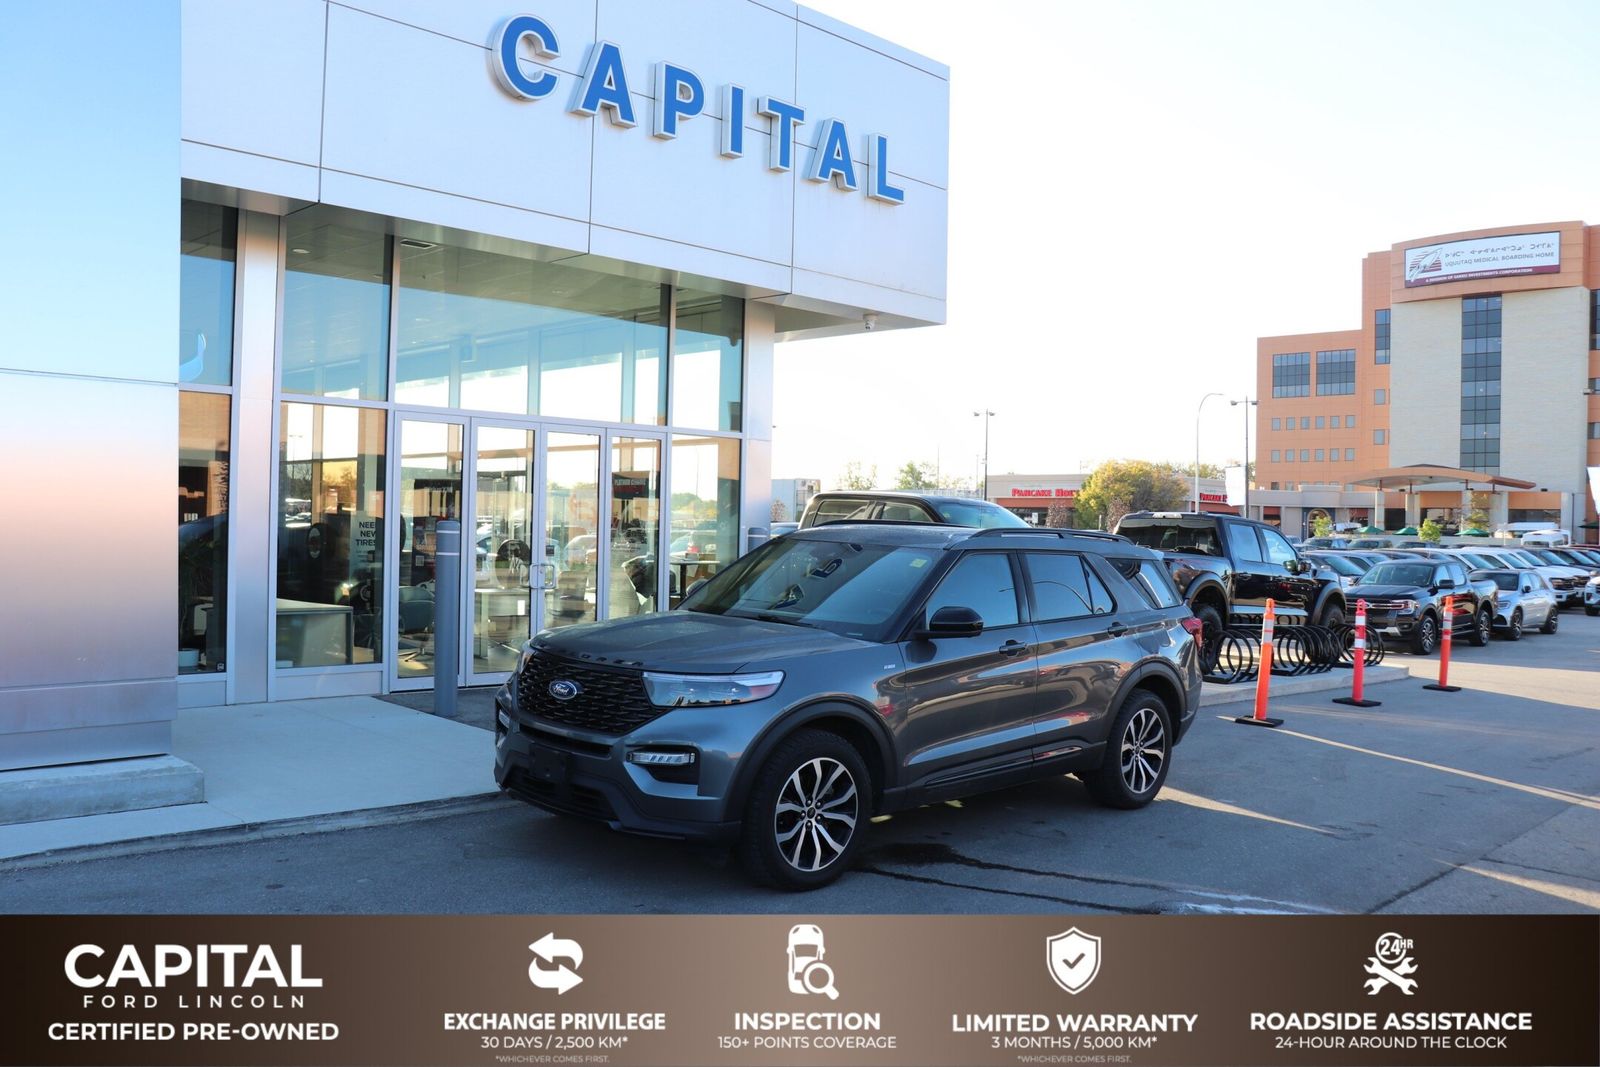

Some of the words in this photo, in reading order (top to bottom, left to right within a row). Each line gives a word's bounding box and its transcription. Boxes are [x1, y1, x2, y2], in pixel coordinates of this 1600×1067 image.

[491, 13, 904, 205] CAPITAL
[1501, 253, 1534, 261] BOARDING
[358, 521, 376, 529] NEE
